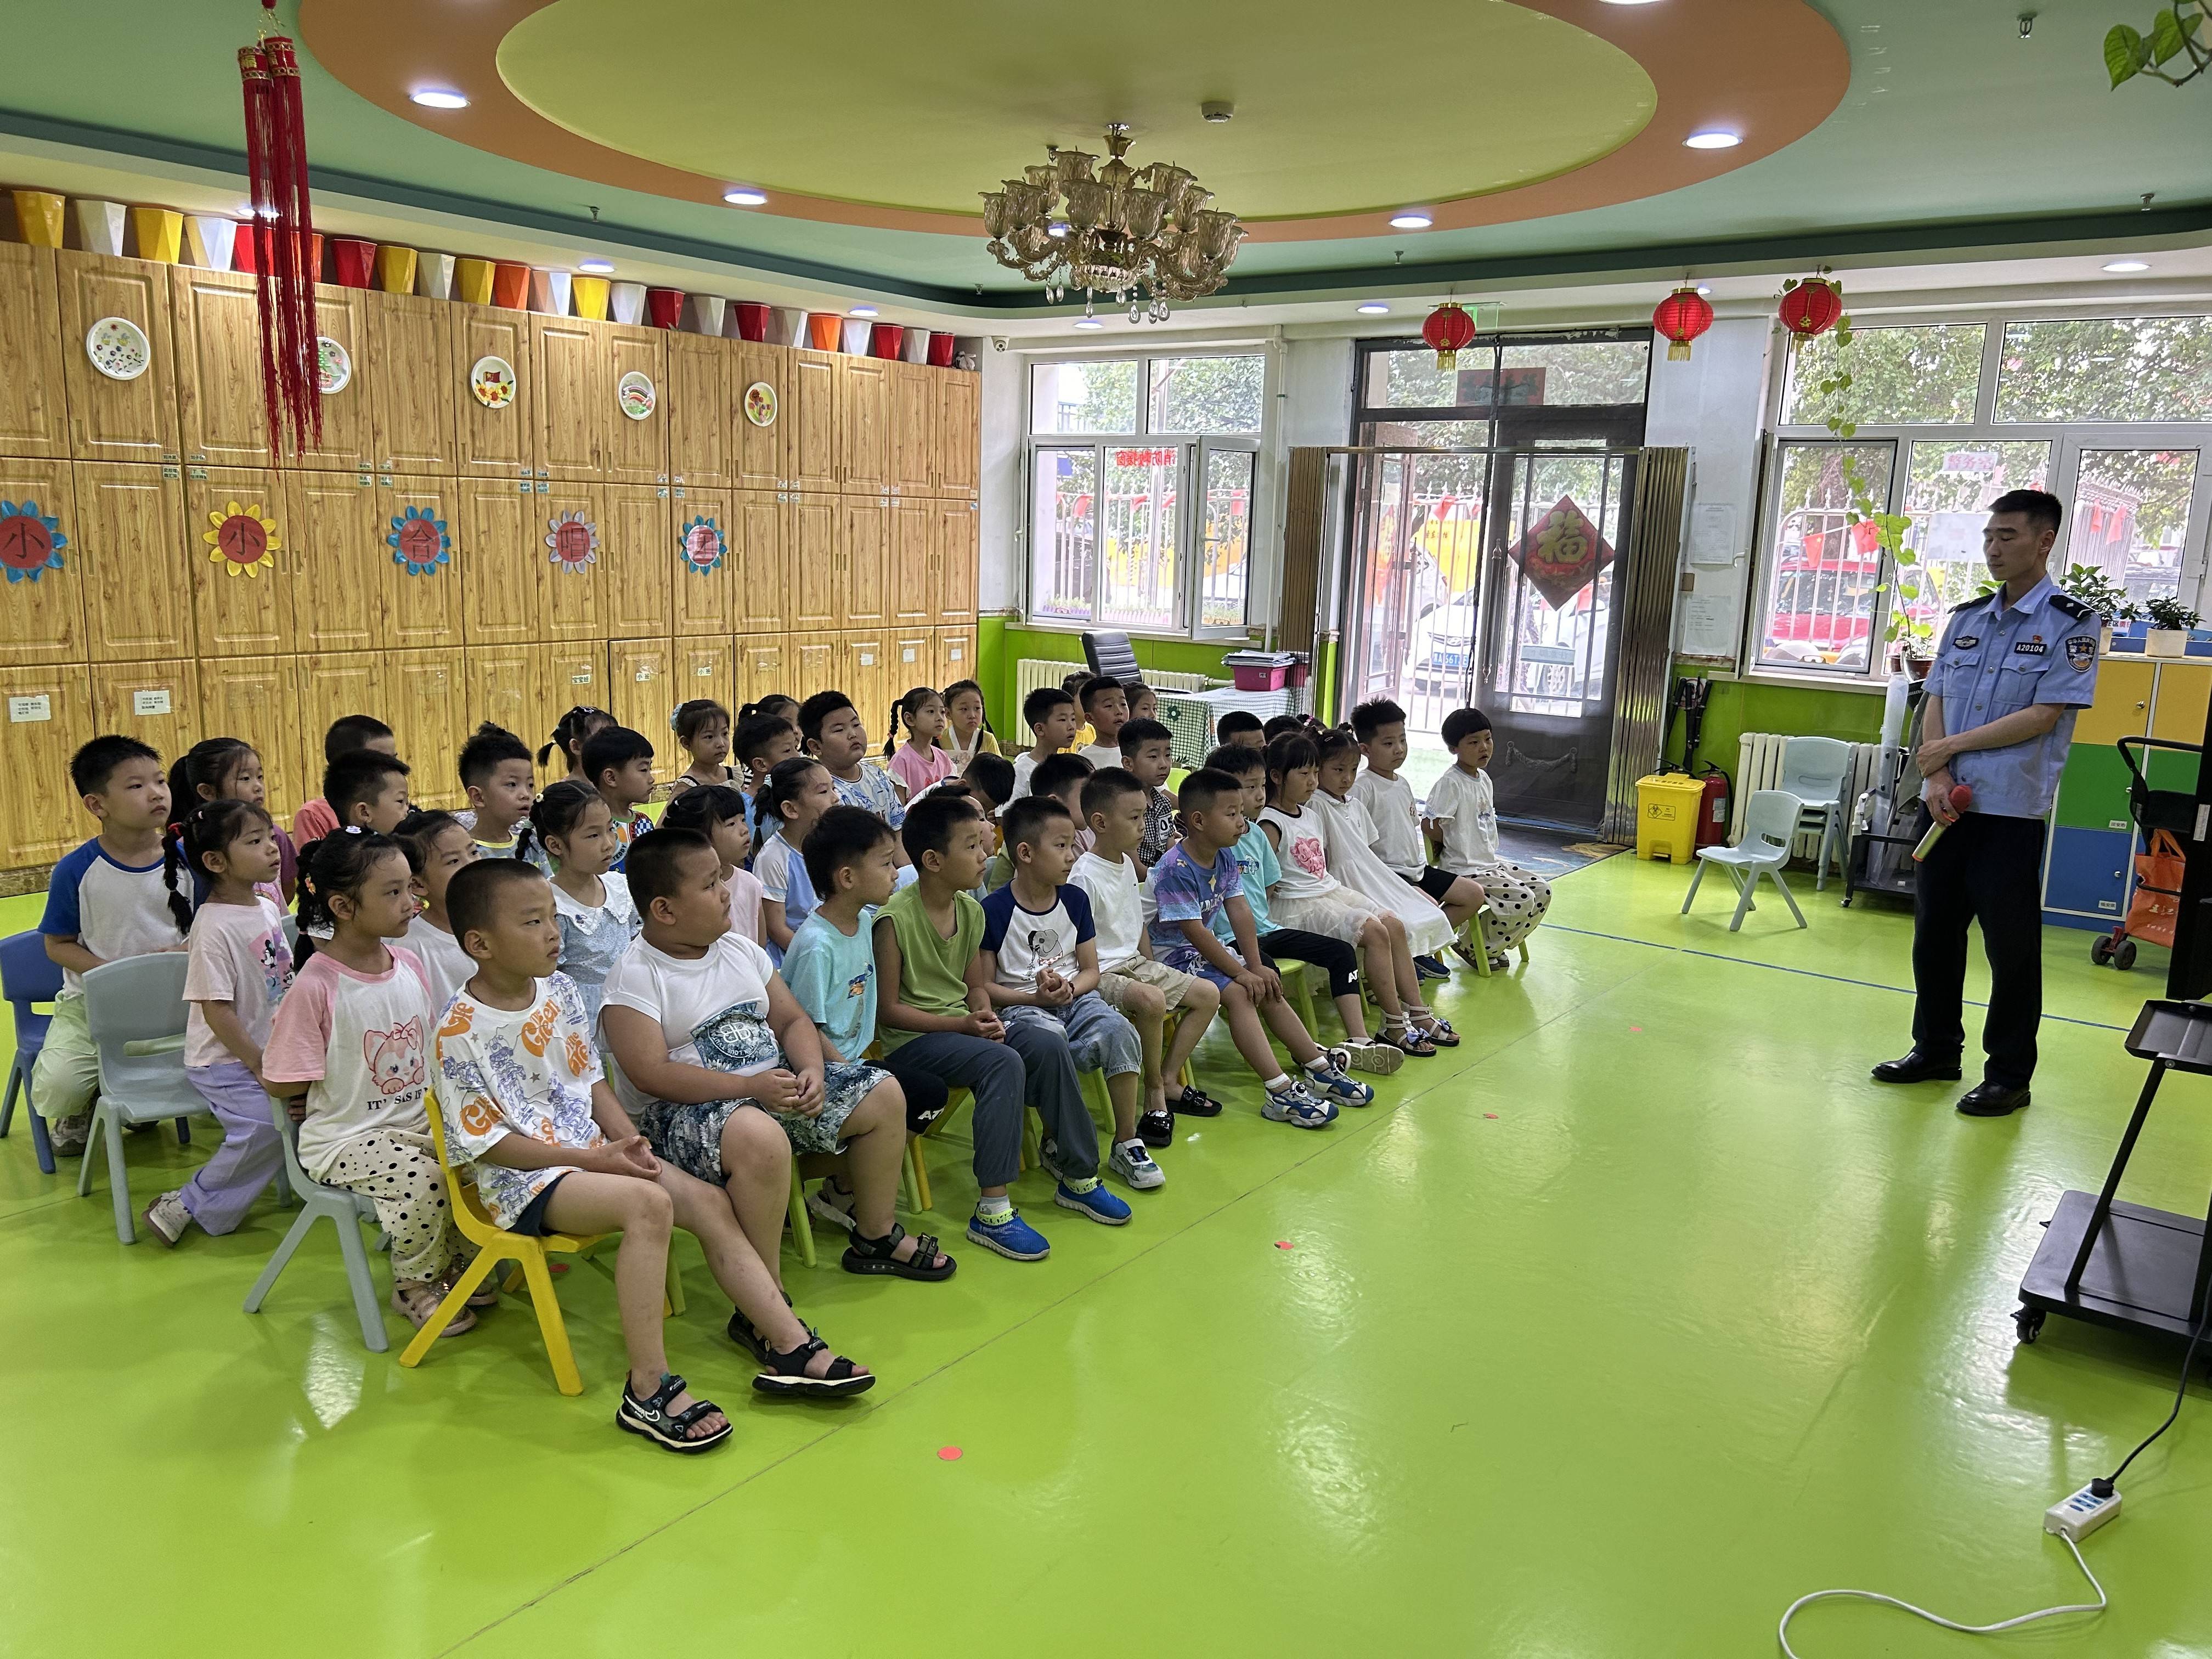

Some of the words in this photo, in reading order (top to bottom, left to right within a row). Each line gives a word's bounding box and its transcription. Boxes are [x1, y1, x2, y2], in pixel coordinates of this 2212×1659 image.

[3, 522, 46, 560] 小
[225, 522, 261, 556] 小
[405, 524, 435, 559] 合
[560, 527, 586, 560] 唱
[1536, 510, 1589, 565] 福
[2016, 644, 2044, 653] A20104
[612, 844, 627, 861] TEDDY
